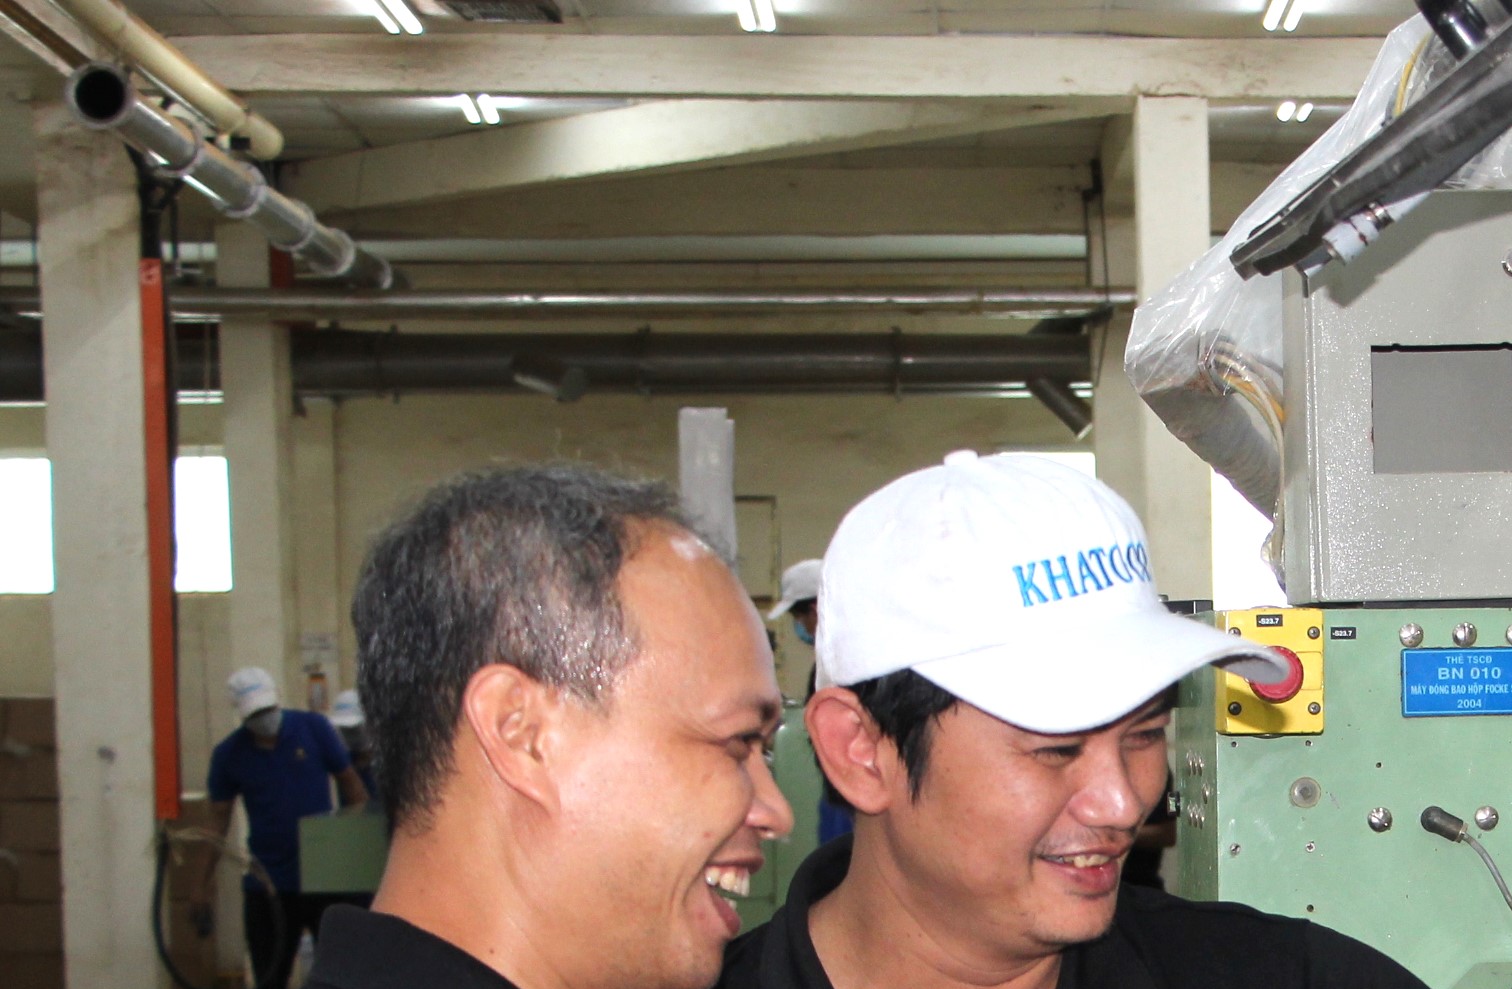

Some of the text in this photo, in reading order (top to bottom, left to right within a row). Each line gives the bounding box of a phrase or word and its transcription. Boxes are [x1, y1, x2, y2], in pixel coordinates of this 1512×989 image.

[1445, 654, 1493, 664] THẺ TSCĐ
[1437, 667, 1501, 680] BN 010
[1411, 683, 1427, 695] MÁY
[1429, 683, 1449, 695] ĐÓNG
[1451, 685, 1466, 694] BAO
[1468, 682, 1483, 696] HỘP
[1485, 684, 1509, 694] FOCKE
[1457, 699, 1482, 709] 2004
